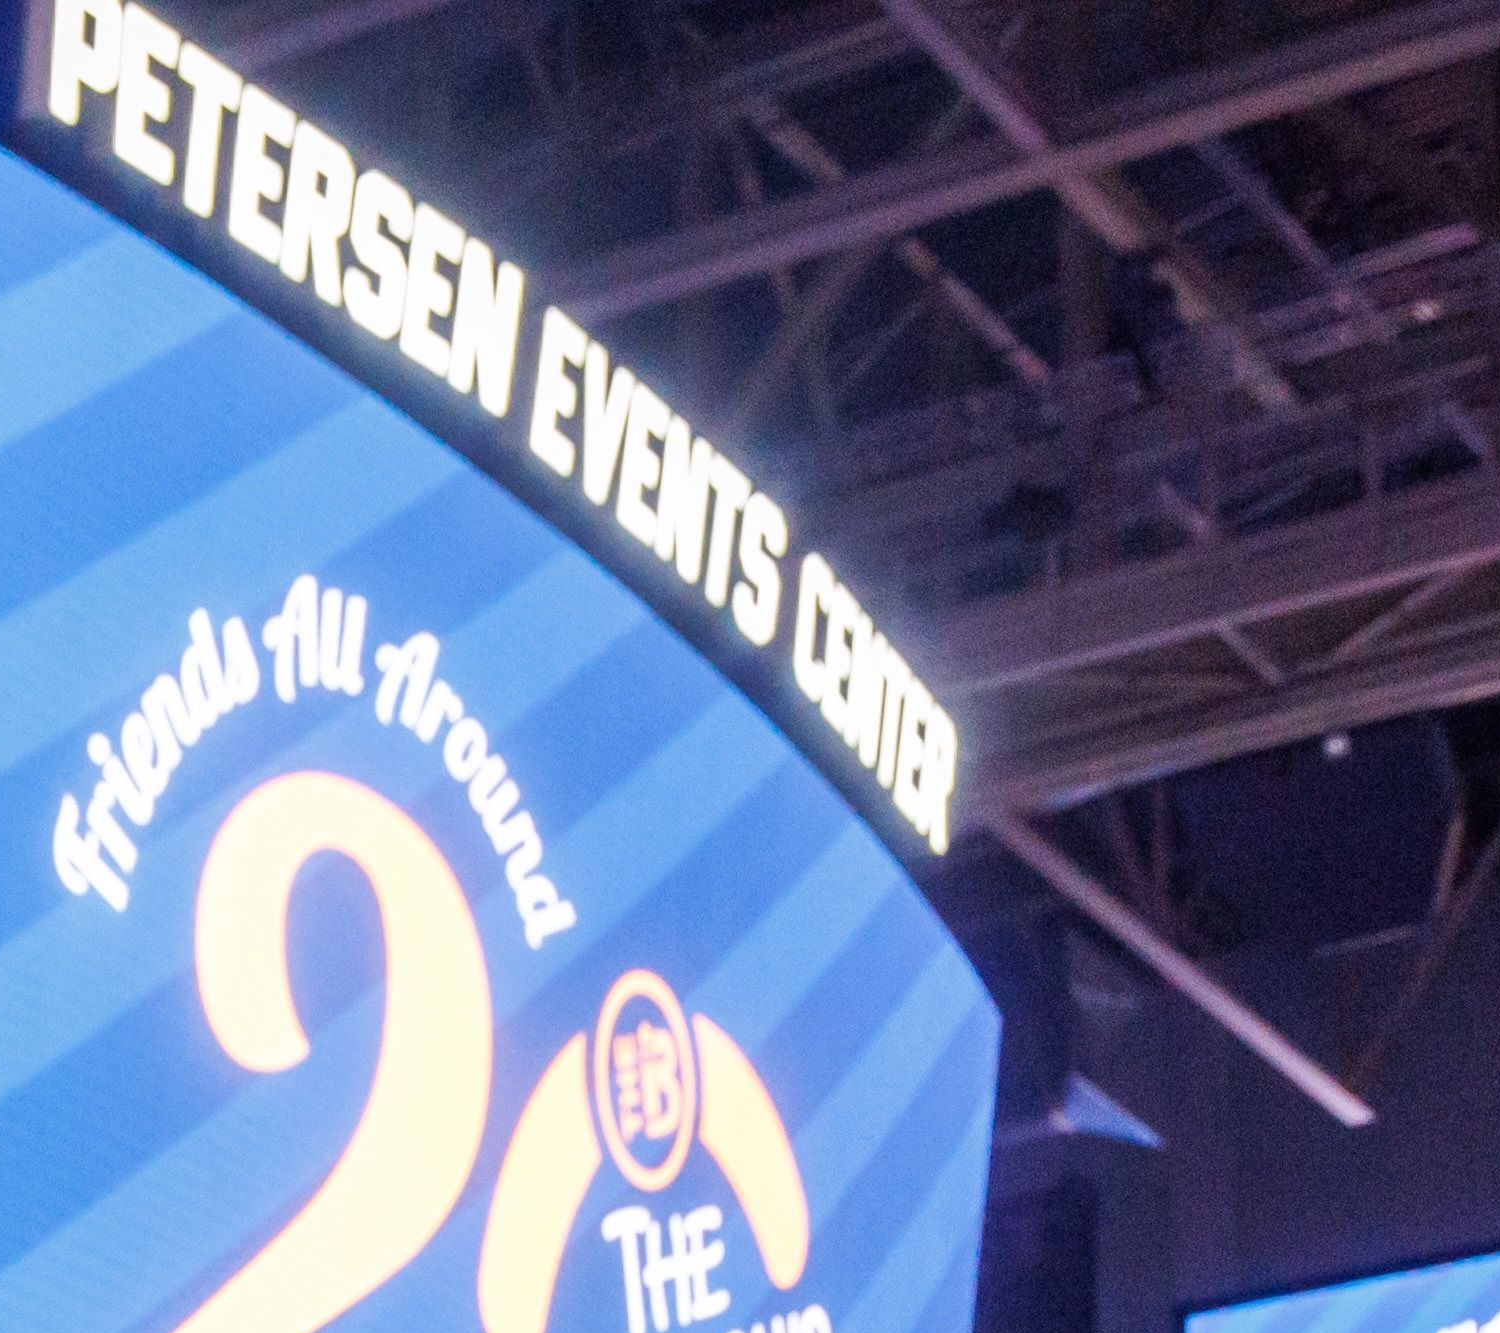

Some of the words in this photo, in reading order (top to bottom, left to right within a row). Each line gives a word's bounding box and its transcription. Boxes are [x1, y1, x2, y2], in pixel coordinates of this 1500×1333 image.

[48, 0, 525, 418] PETERSEN
[530, 306, 787, 647] EVENTS
[793, 553, 957, 855] CENTER
[53, 608, 261, 913] Friends
[264, 573, 368, 702] All
[375, 631, 577, 950] Around
